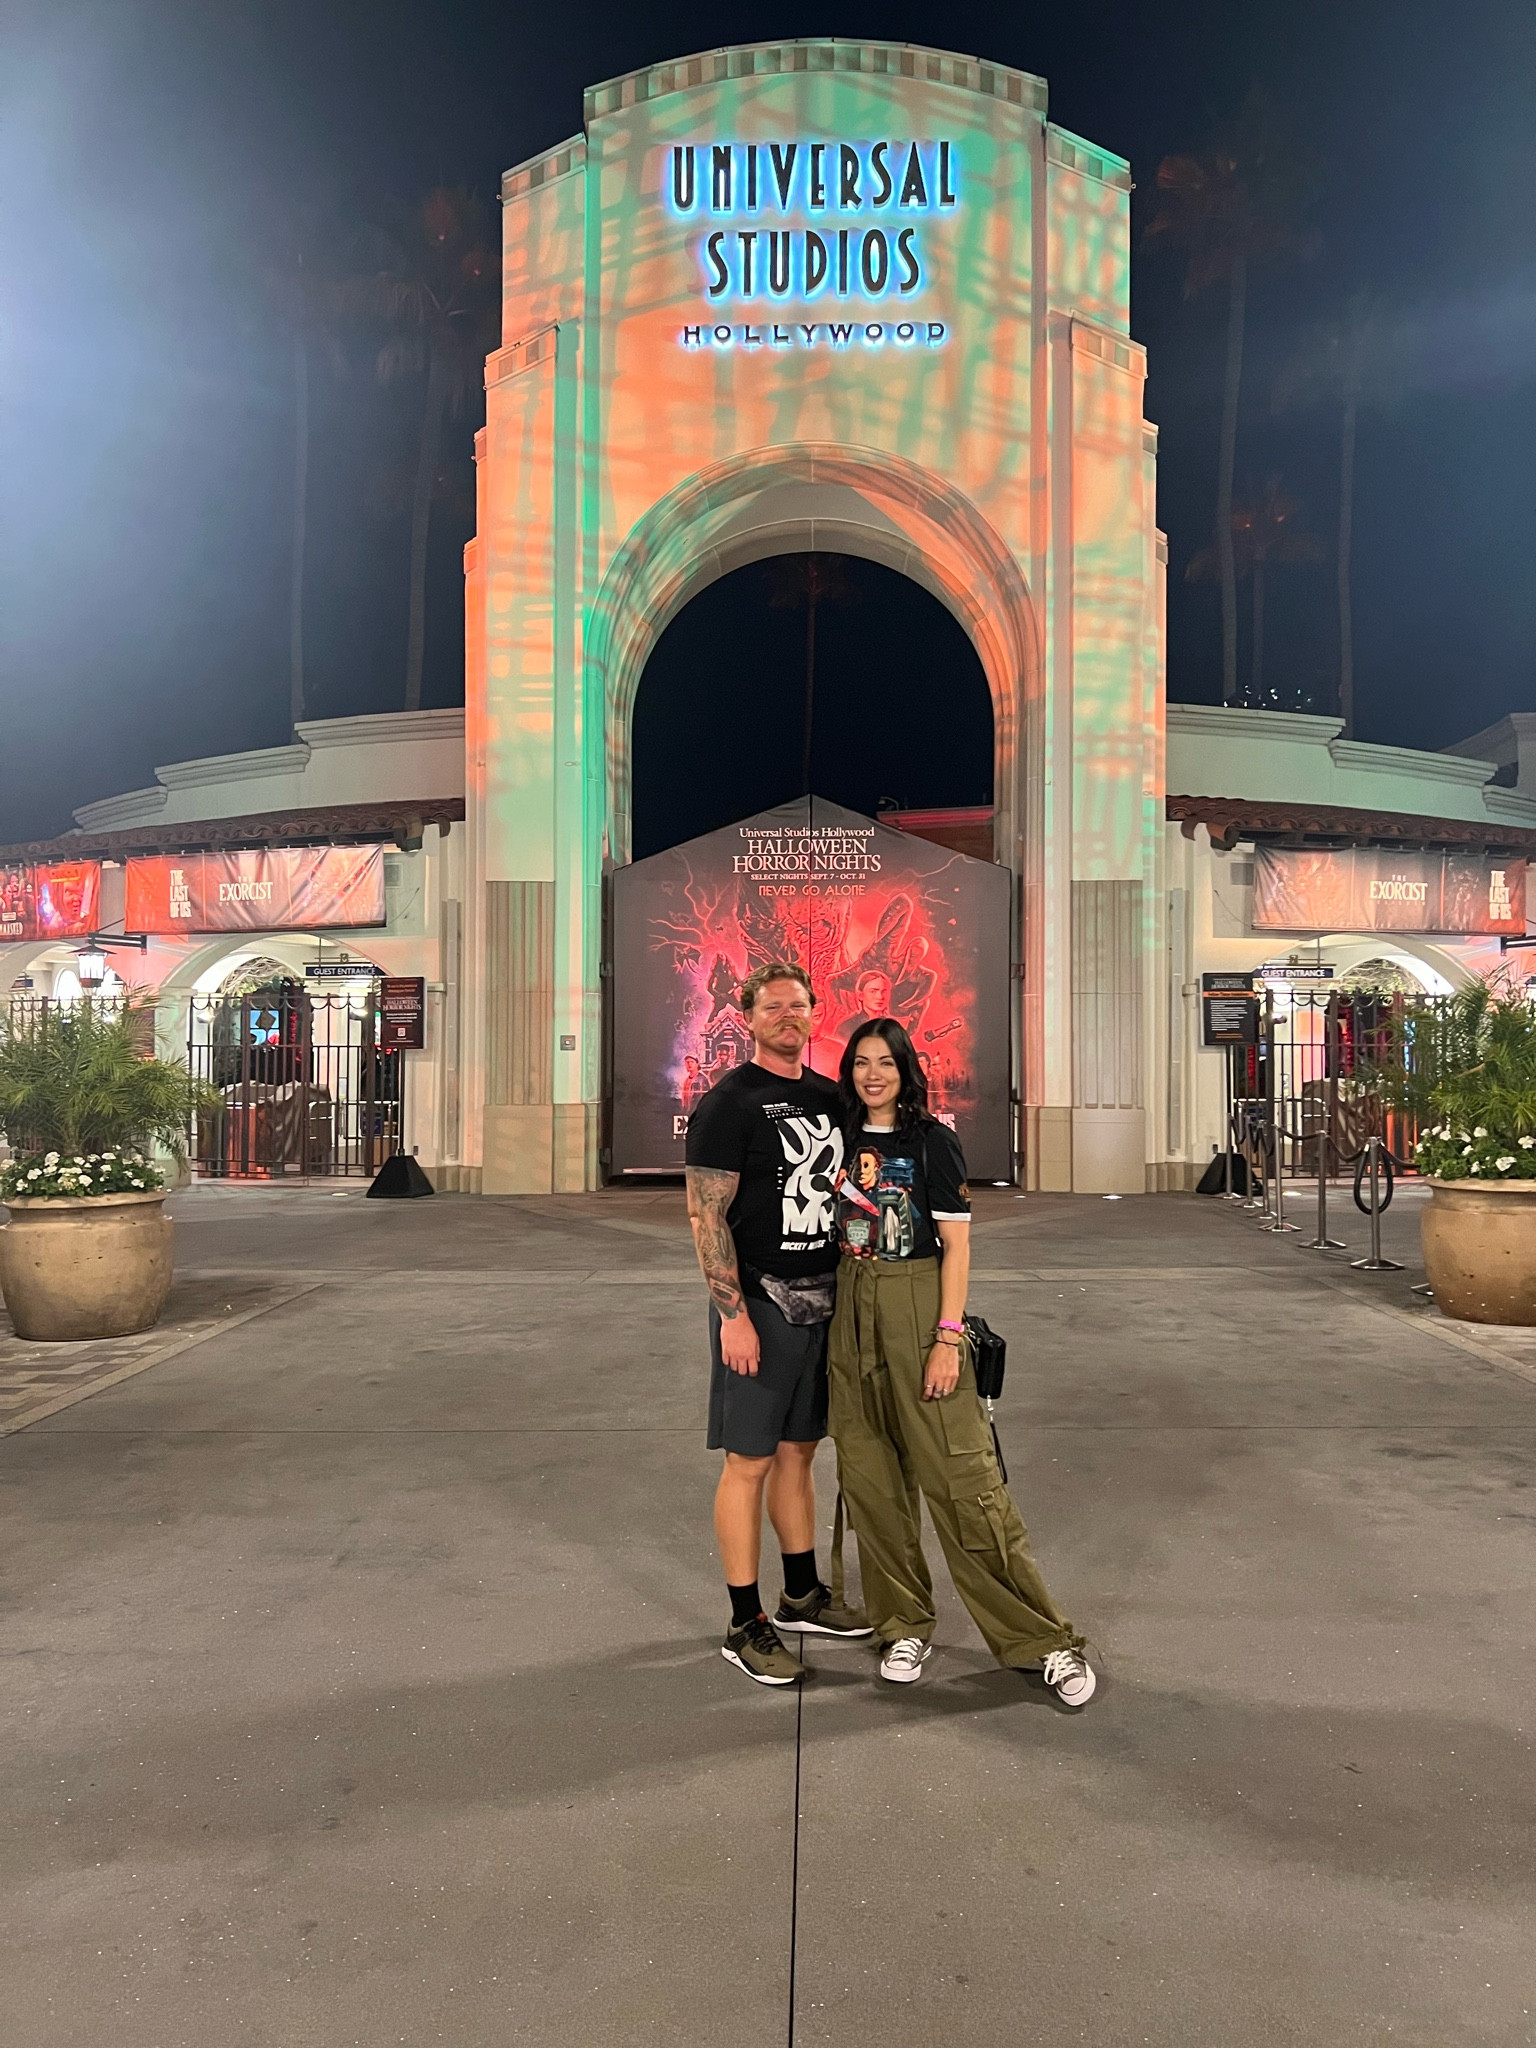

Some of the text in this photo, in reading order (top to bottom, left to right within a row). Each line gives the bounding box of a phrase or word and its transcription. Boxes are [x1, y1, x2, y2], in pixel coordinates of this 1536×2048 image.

[673, 141, 956, 211] UNIVERSAL
[707, 228, 920, 298] STUDIOS
[683, 322, 945, 346] HOLLYWOOD
[739, 827, 875, 840] Universal Studios Hollywood
[748, 838, 867, 855] HALLOWEEN
[732, 854, 881, 873] HORROR NIGHTS
[170, 869, 184, 886] THE
[1491, 870, 1506, 887] THE
[170, 885, 188, 902] LAST
[219, 881, 273, 901] EXORCIST
[758, 884, 866, 896] NEVER GO ALONE
[1370, 880, 1428, 901] EXORCIST
[1489, 886, 1510, 903] LAST
[170, 901, 192, 918] OF US
[313, 967, 376, 976] GUEST ENTRANCE
[1261, 969, 1325, 977] GUEST ENTRANCE
